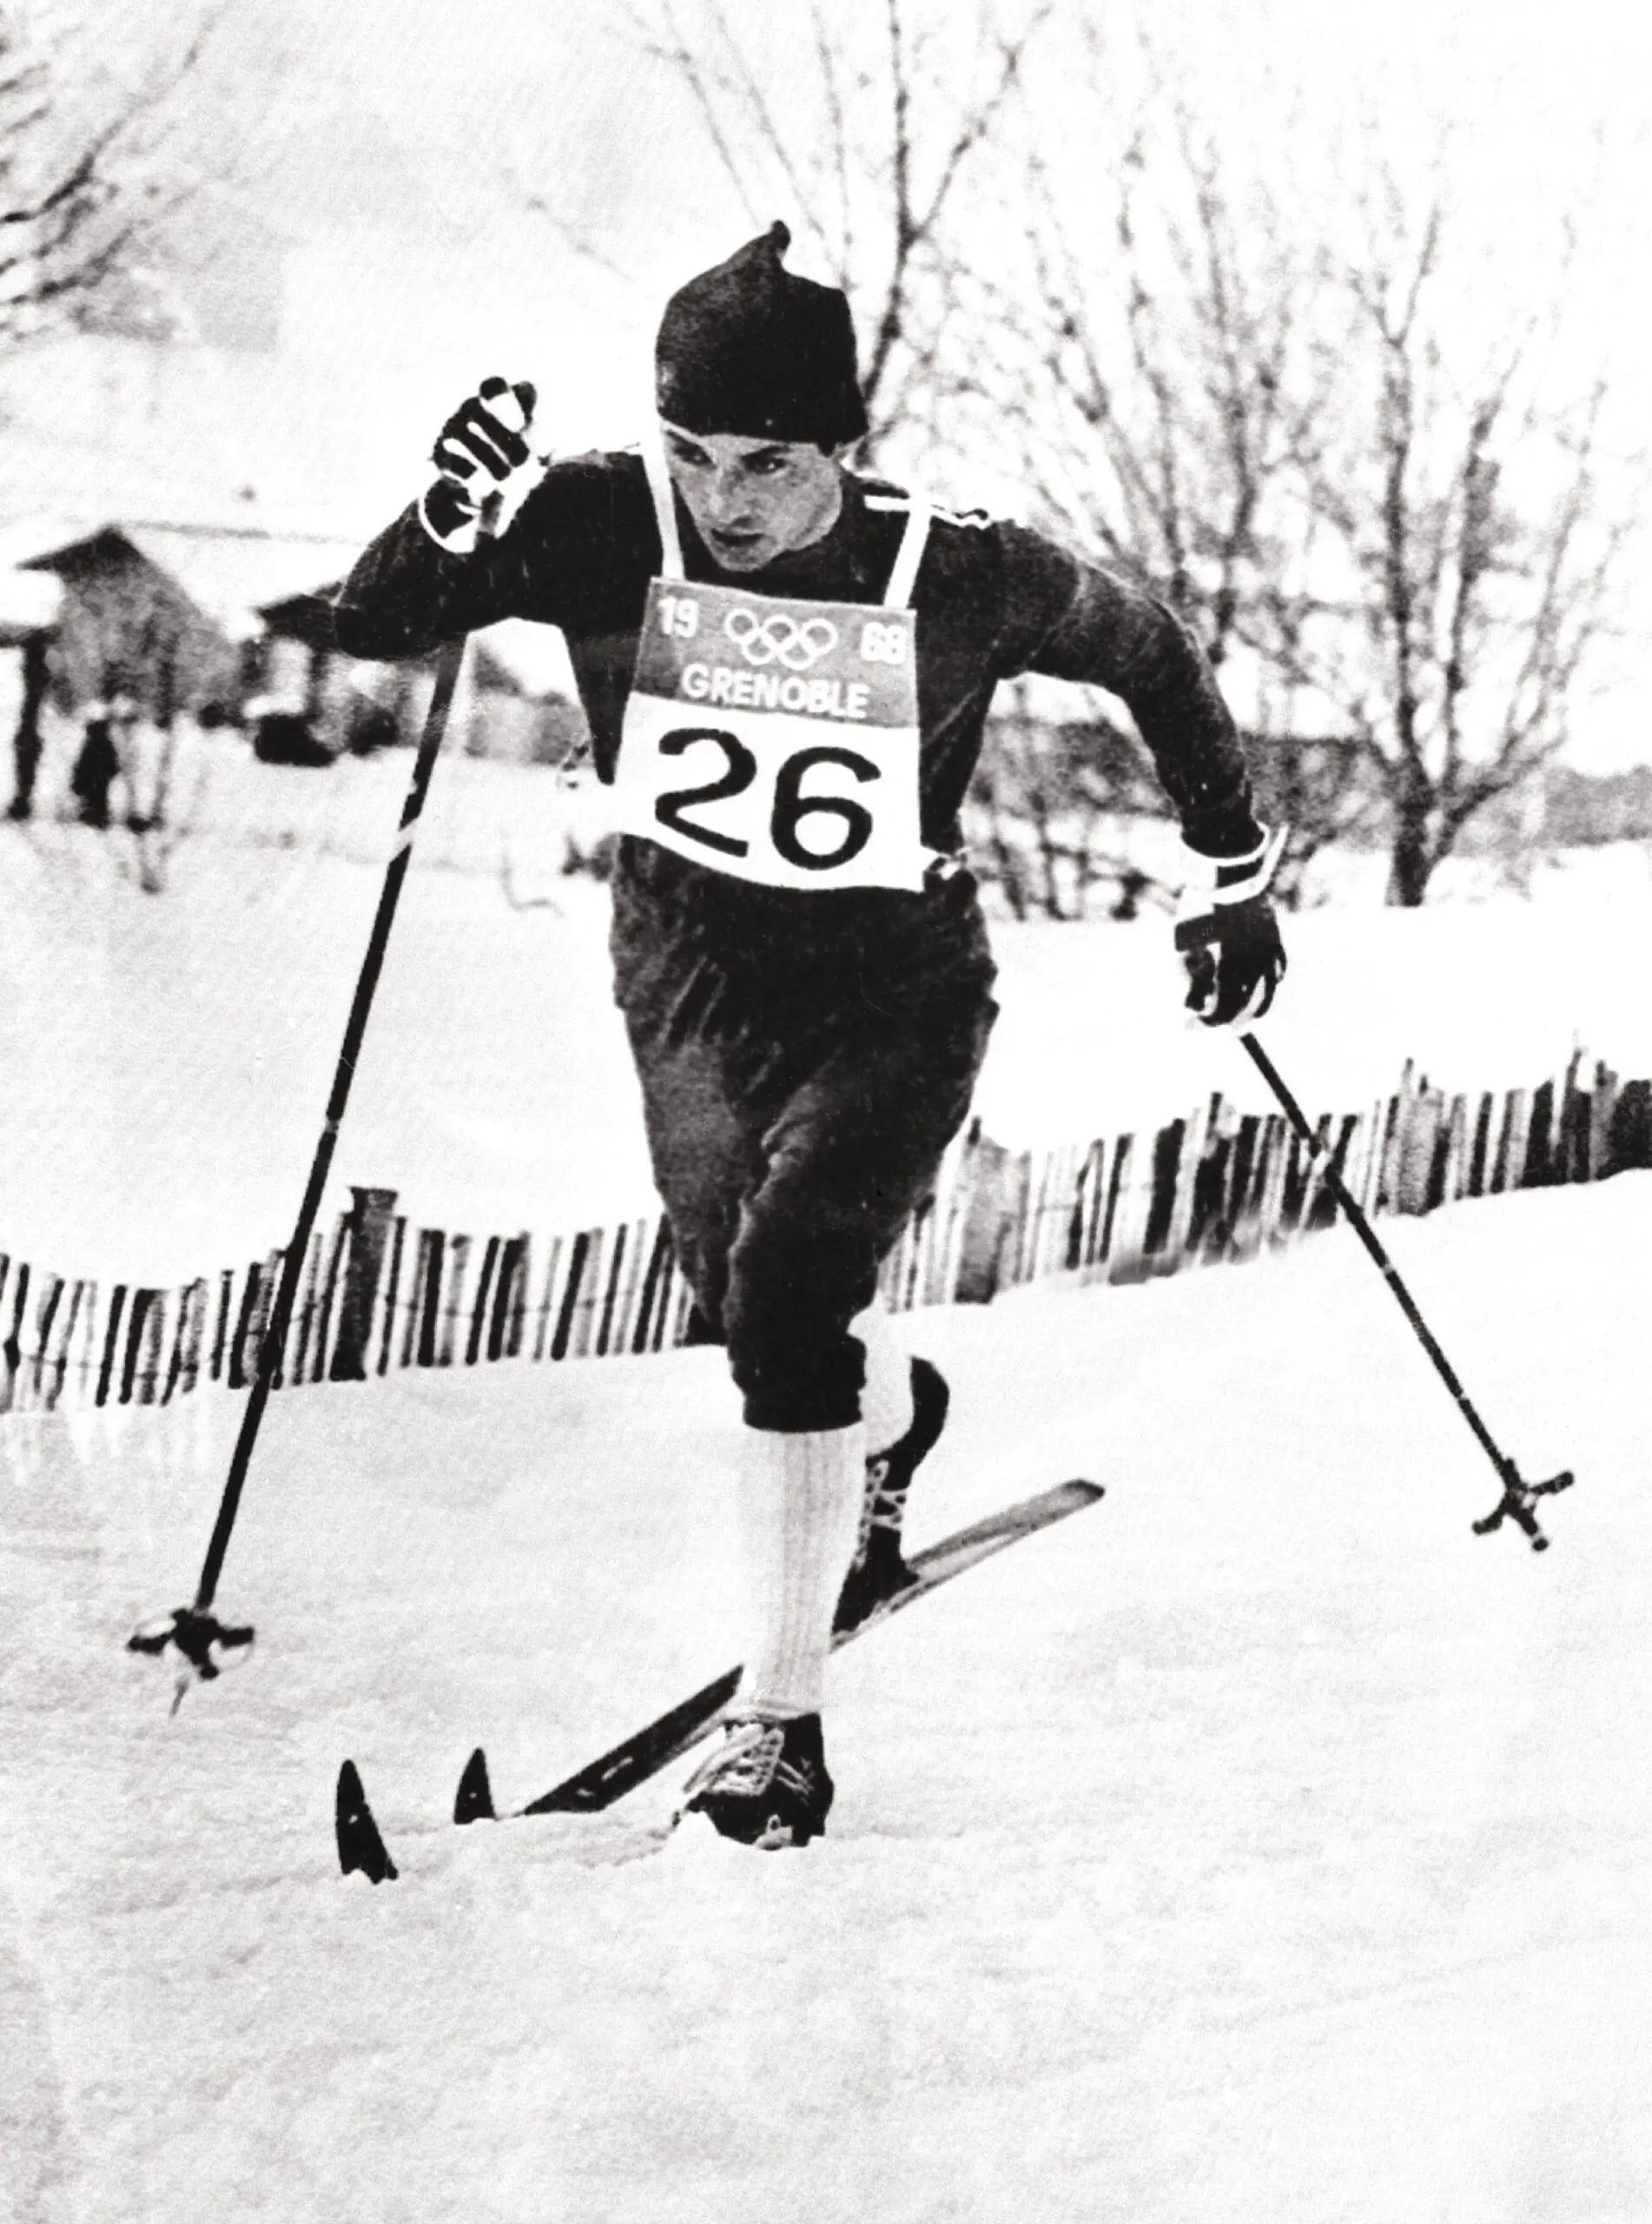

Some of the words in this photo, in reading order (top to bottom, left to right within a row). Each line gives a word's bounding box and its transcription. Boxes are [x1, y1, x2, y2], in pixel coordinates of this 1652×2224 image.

[657, 596, 698, 639] 19
[680, 663, 869, 718] GRENOBLE
[655, 727, 882, 871] 26
